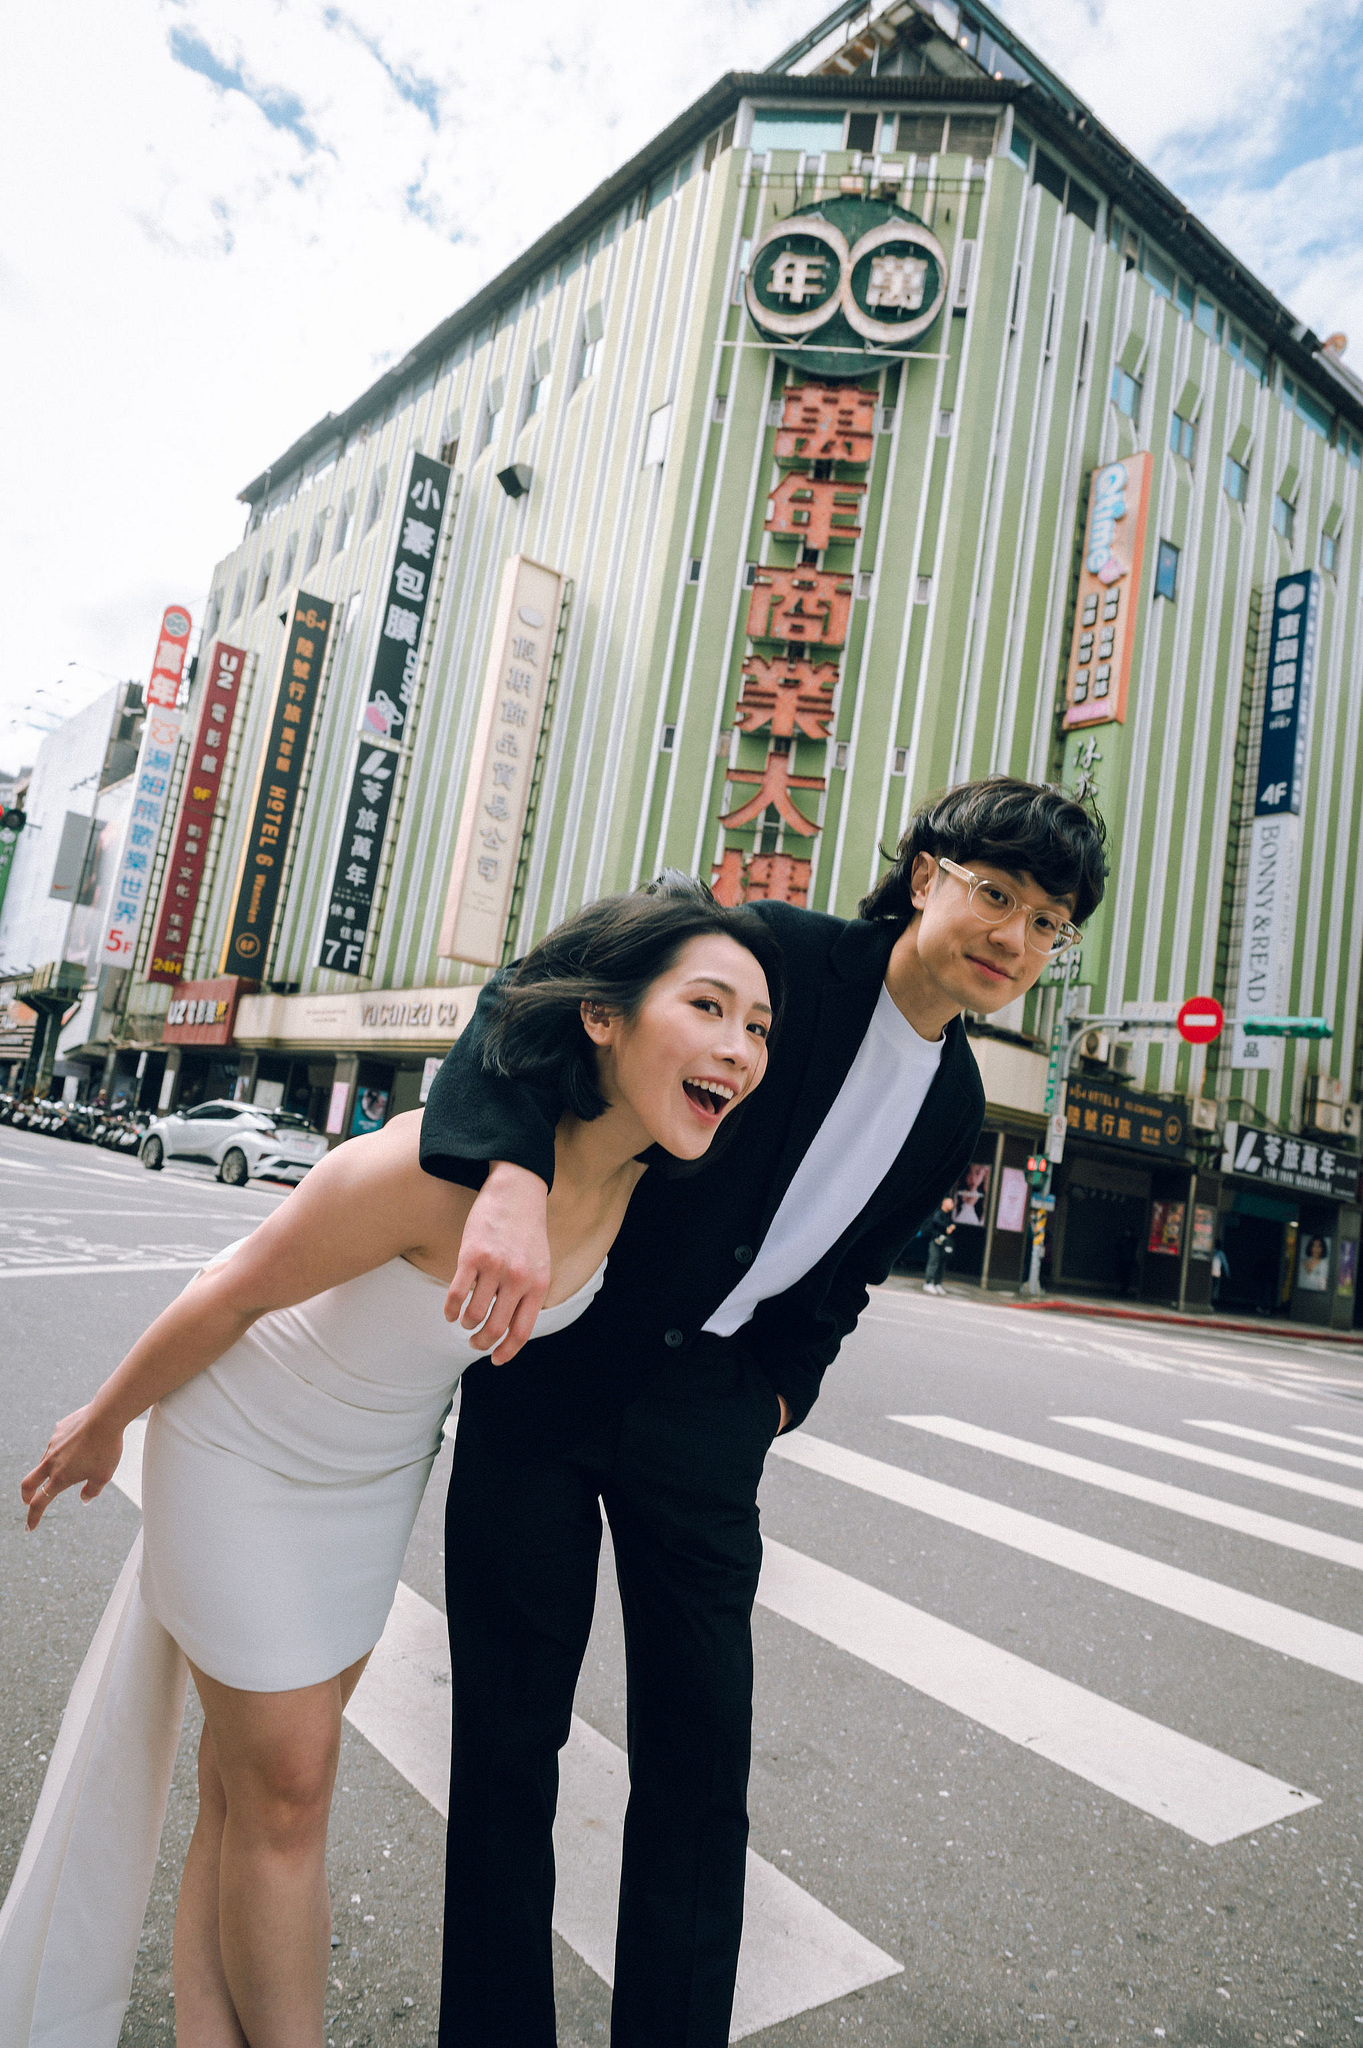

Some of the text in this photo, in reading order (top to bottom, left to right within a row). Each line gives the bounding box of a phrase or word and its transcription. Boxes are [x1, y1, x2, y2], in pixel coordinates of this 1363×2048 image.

[384, 477, 441, 646] 小豪包膜
[150, 640, 184, 706] 萬年
[216, 651, 239, 690] U2
[477, 637, 538, 882] 假期飾品貿易公司
[255, 784, 287, 867] HOTEL 6
[1260, 781, 1288, 805] 4F
[113, 748, 172, 923] 湯姆熊歡樂世界
[105, 929, 132, 955] 5F
[1248, 824, 1280, 1003] BONNY&READ
[152, 957, 181, 975] 24H
[324, 938, 362, 969] 7F
